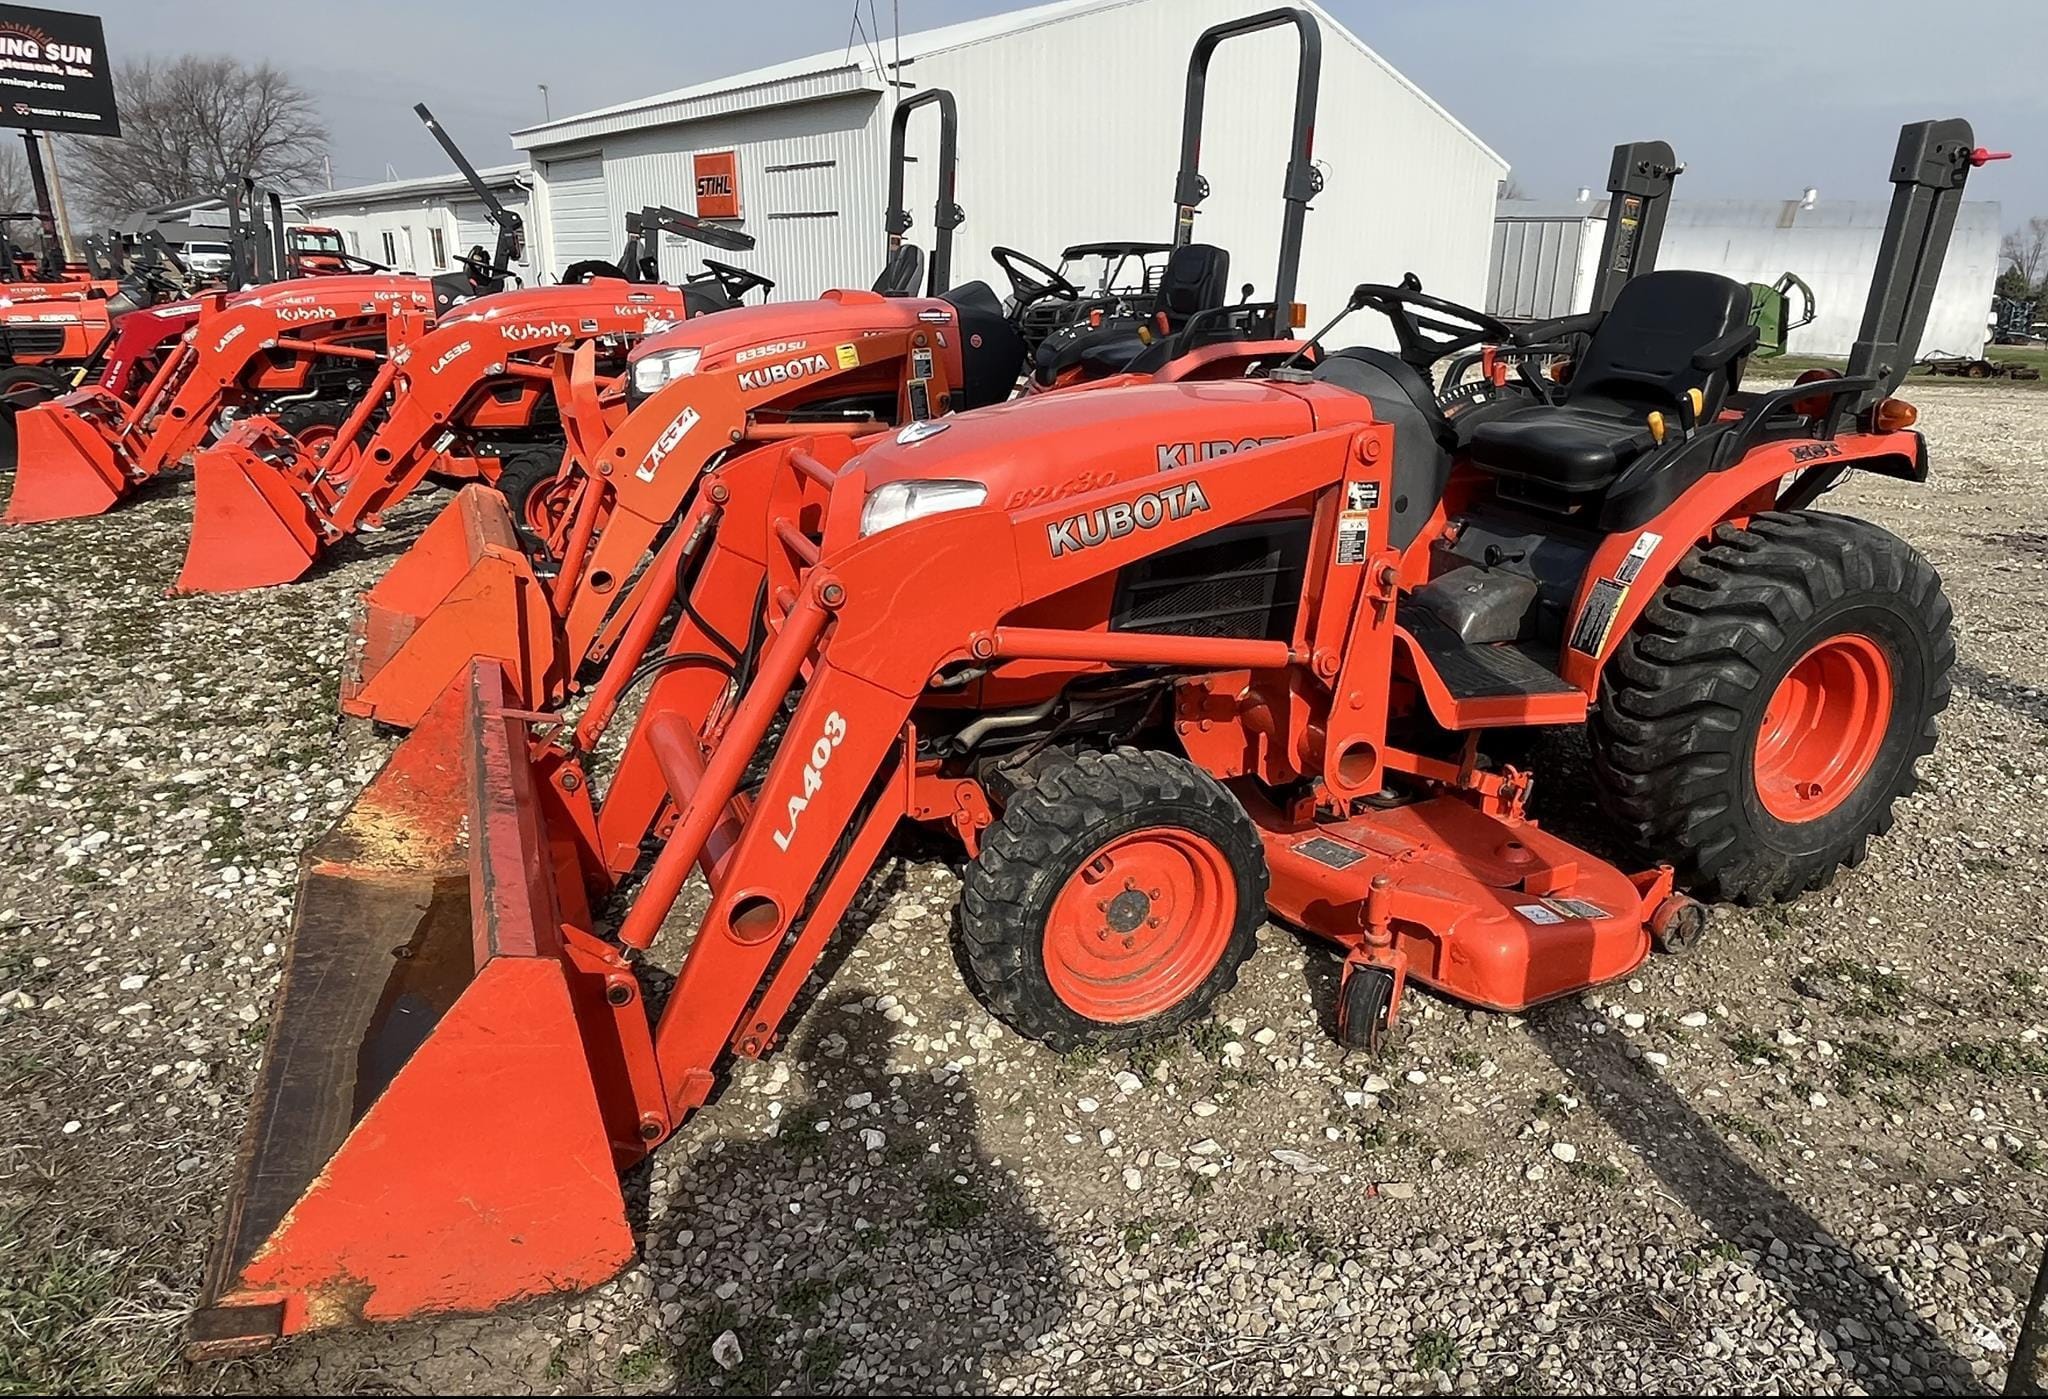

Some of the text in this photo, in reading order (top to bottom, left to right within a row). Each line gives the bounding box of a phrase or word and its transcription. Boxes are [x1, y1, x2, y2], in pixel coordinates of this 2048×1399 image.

[45, 43, 92, 65] SUN
[697, 175, 732, 196] STIHL
[276, 305, 337, 321] Kubota
[500, 321, 572, 341] Kubota
[430, 340, 472, 375] LA535
[738, 353, 831, 391] KUBOTA
[1047, 480, 1211, 557] KUBOTA
[772, 710, 847, 853] LA403
